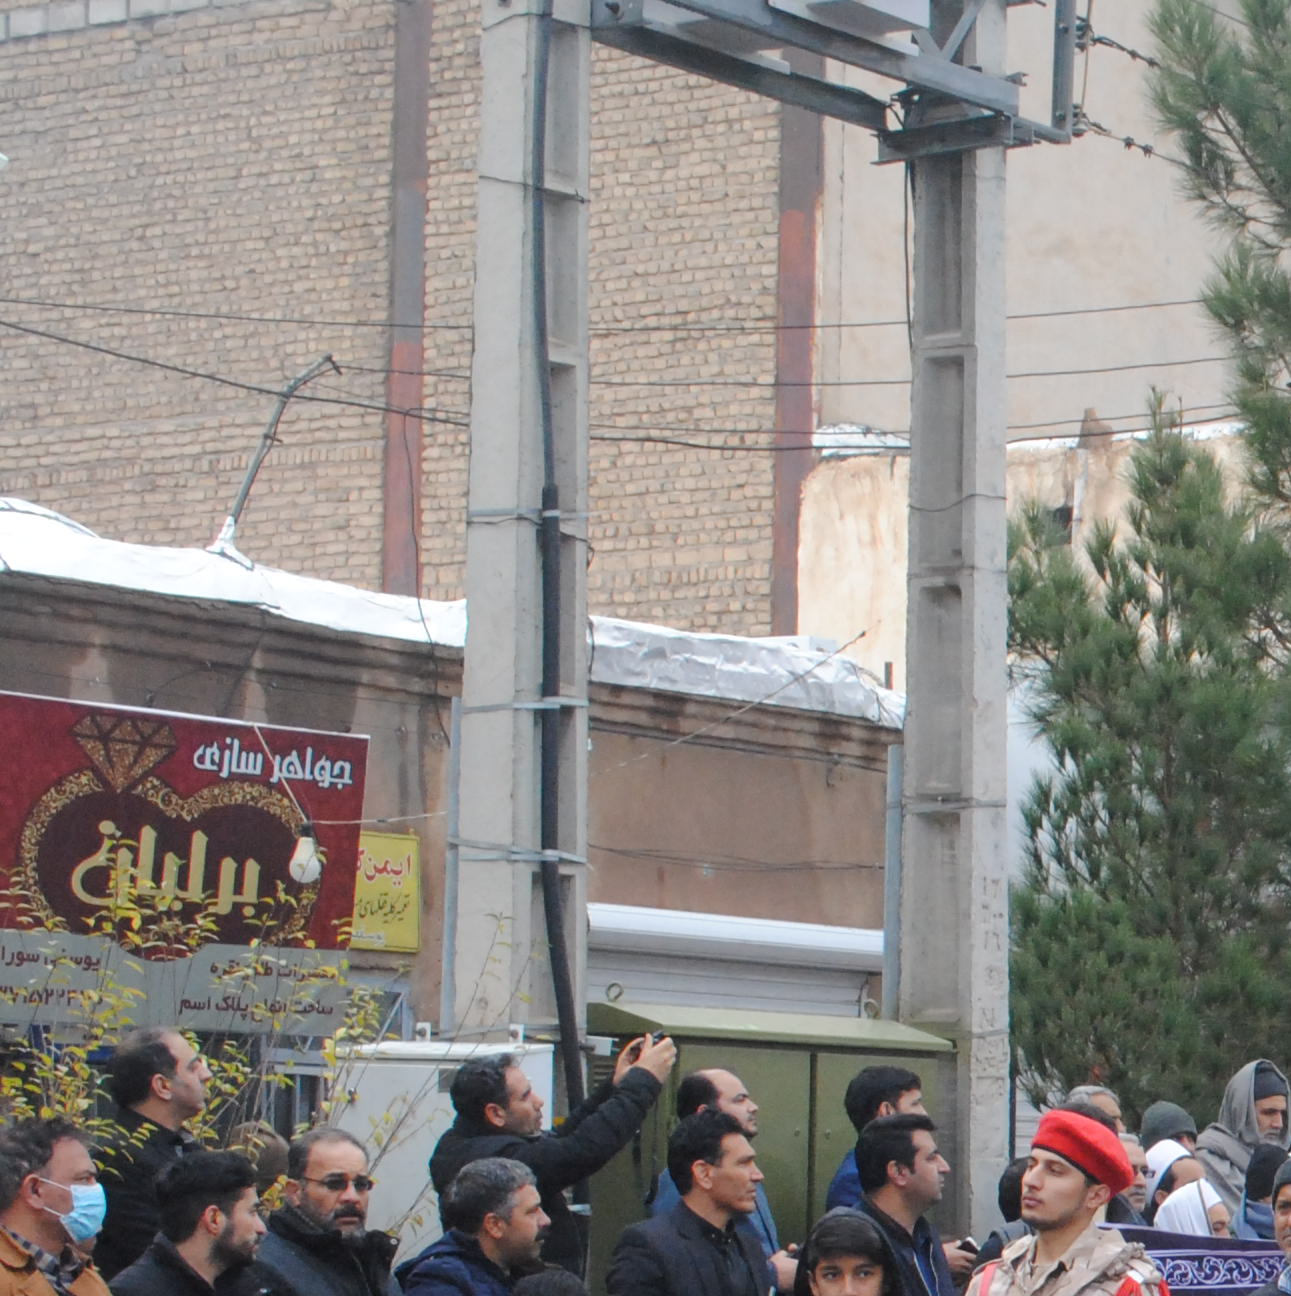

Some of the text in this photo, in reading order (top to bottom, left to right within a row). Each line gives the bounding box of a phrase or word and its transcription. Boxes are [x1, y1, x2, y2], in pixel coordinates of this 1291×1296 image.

[193, 736, 354, 790] جواهر سازی
[364, 853, 412, 887] ایمن
[178, 996, 211, 1016] اسم
[215, 995, 249, 1021] پلاک
